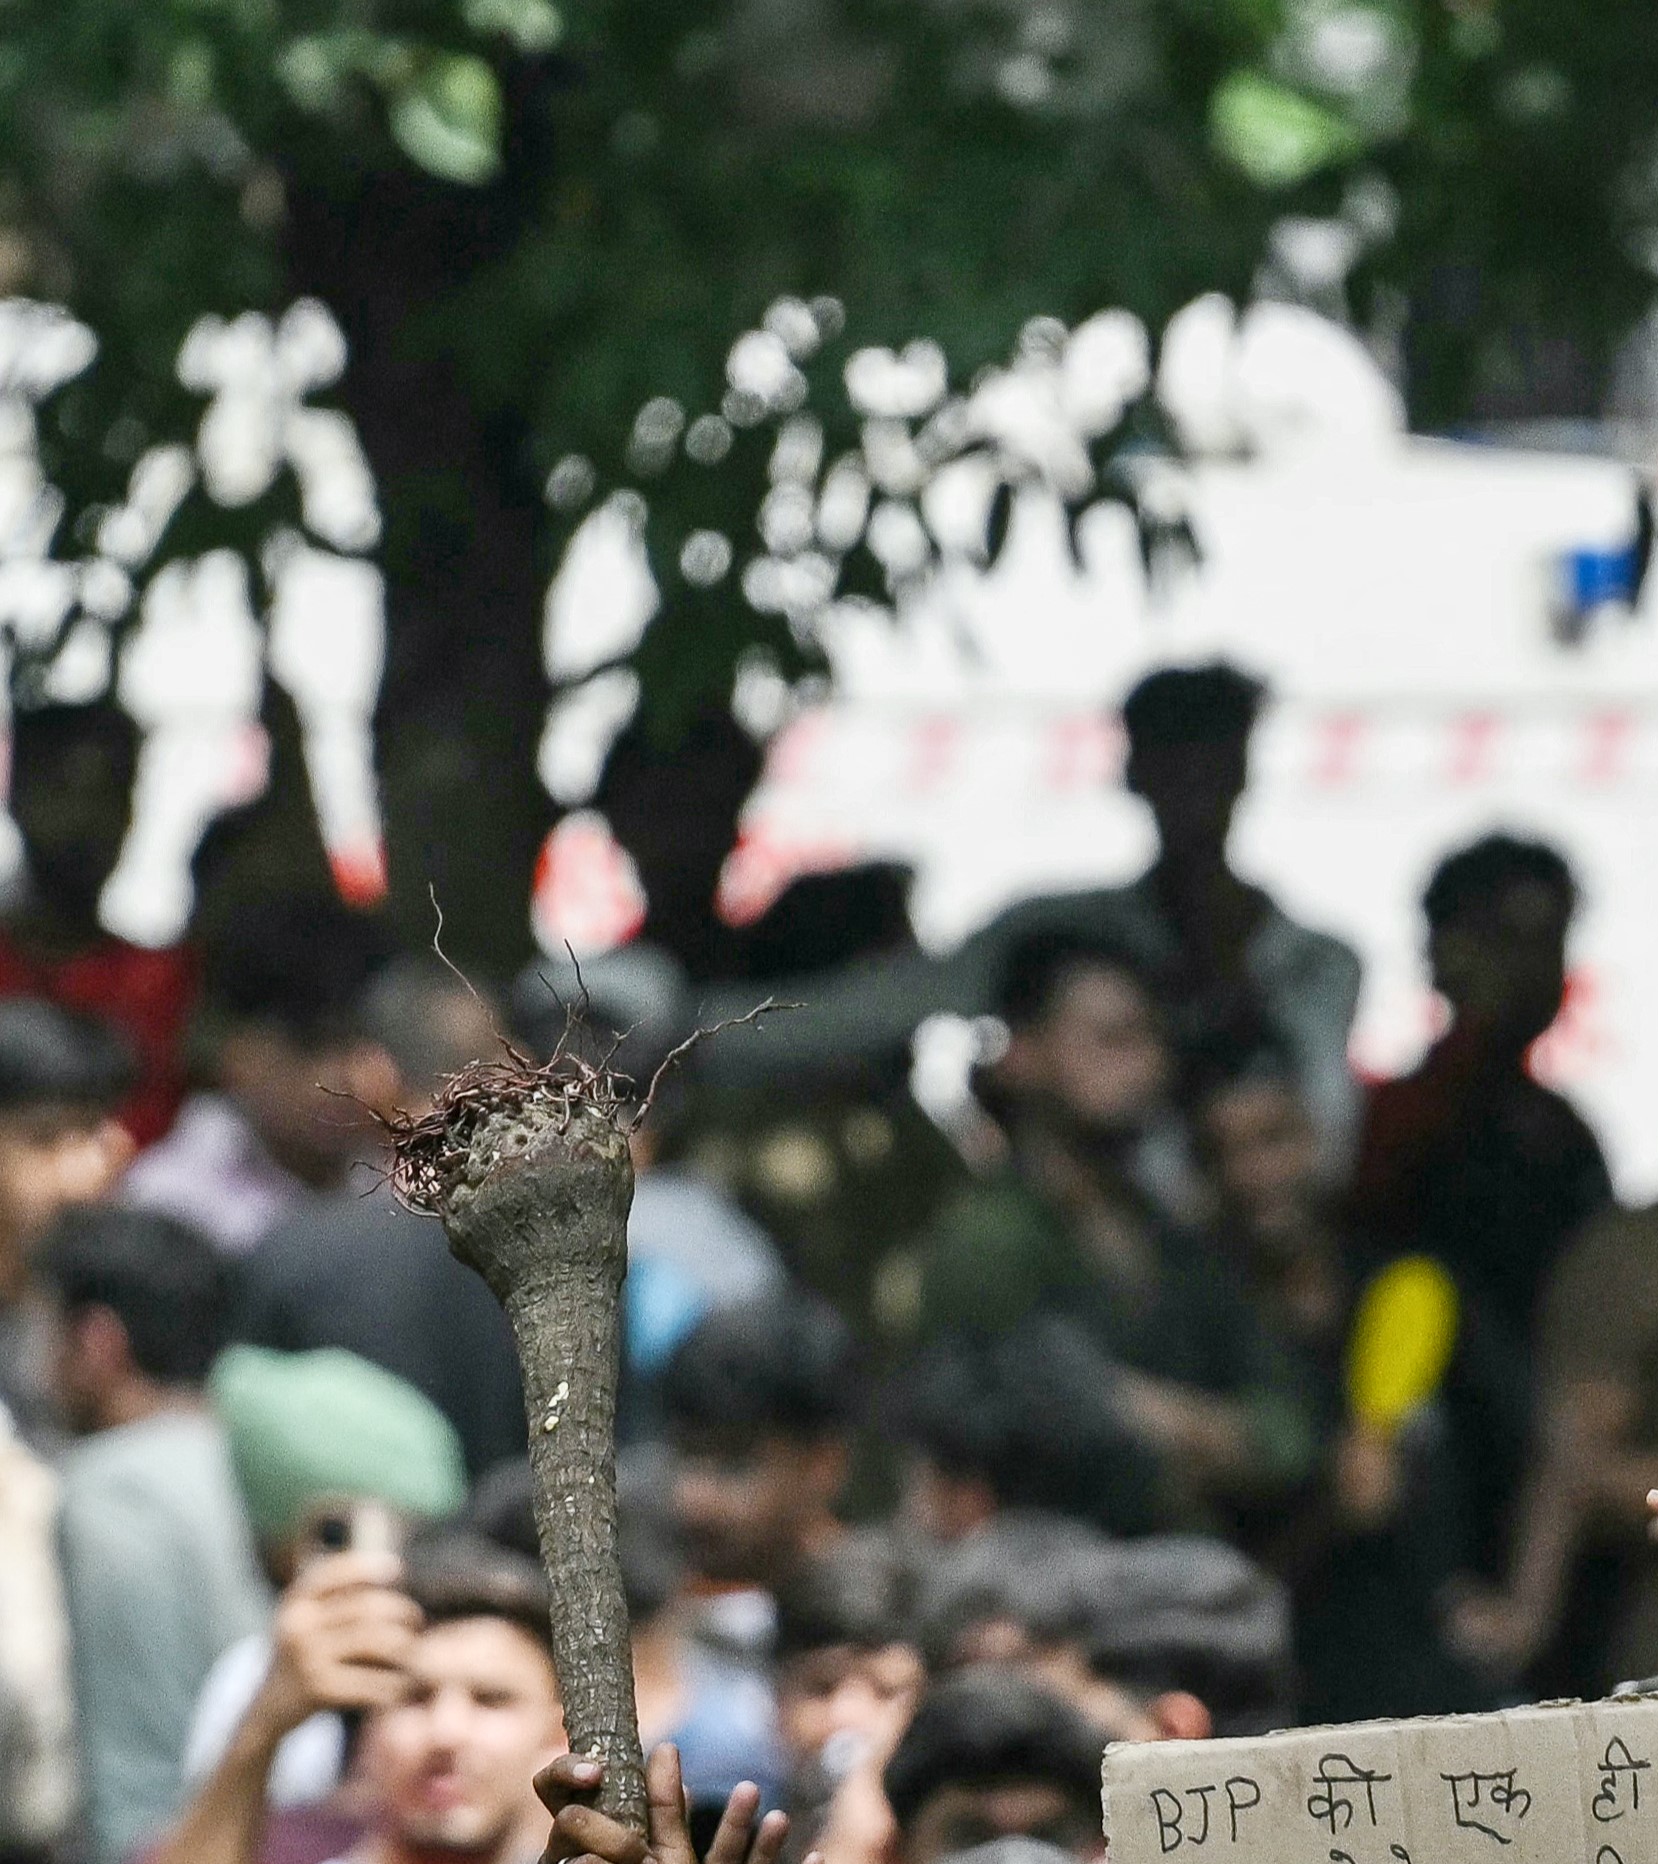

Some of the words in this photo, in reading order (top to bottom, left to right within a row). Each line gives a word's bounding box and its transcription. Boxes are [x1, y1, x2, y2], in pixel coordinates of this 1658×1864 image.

[1150, 1776, 1261, 1854] BJP
[1307, 1753, 1392, 1835] की
[1440, 1768, 1532, 1845] एक
[1592, 1736, 1651, 1822] ही
